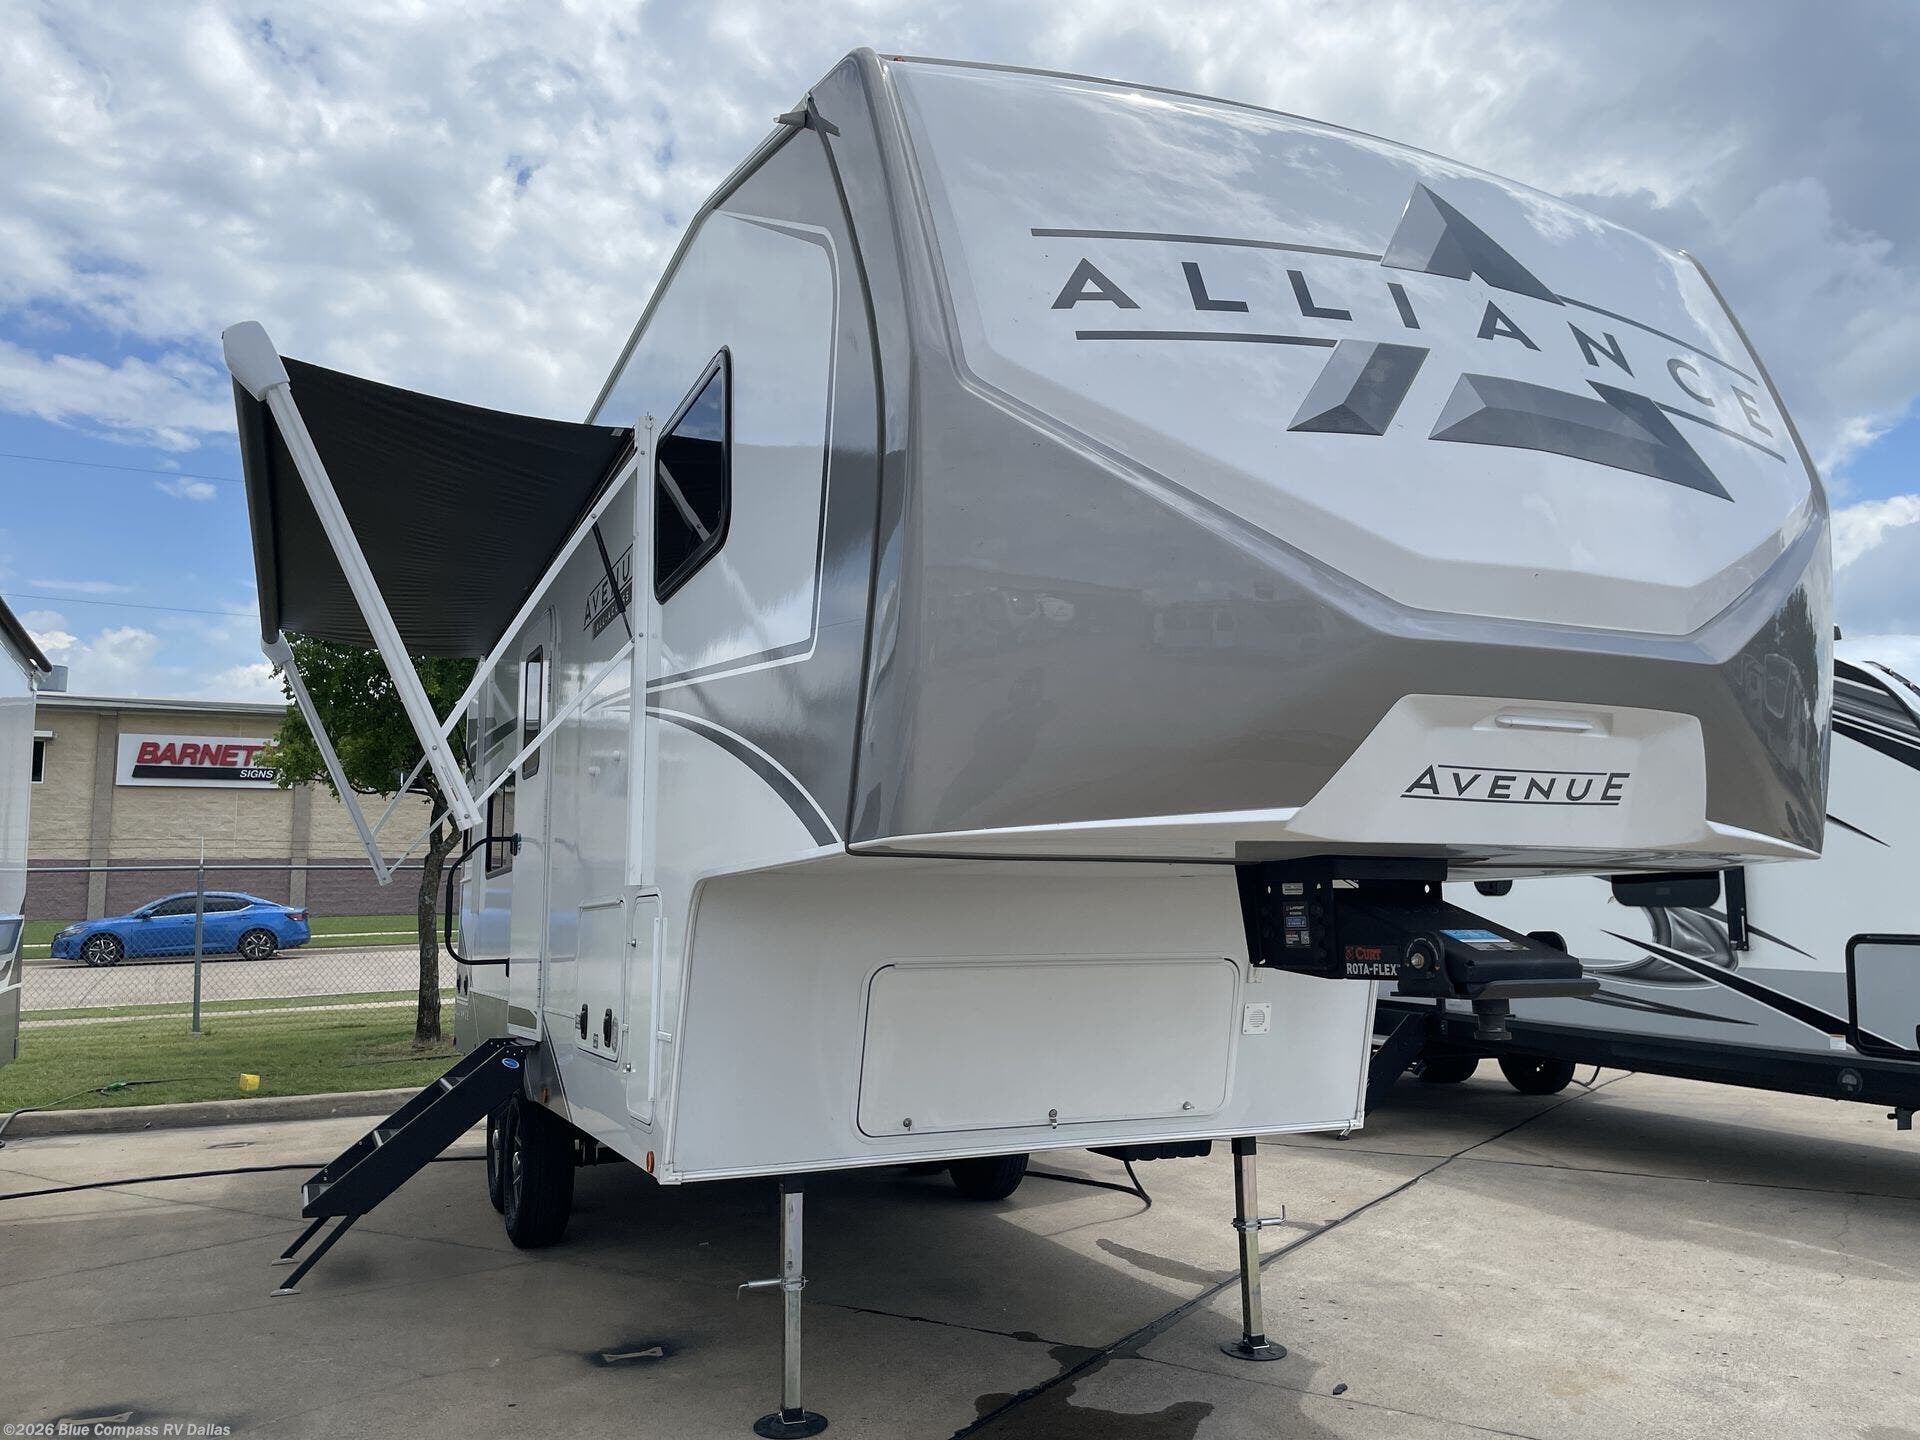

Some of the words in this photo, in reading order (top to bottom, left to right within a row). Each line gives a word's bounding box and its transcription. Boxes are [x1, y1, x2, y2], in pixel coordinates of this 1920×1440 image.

[1051, 257, 1774, 438] ALLIANCE
[584, 554, 631, 627] AVEU
[239, 769, 274, 779] SIGNS
[1404, 765, 1631, 803] AVENUE
